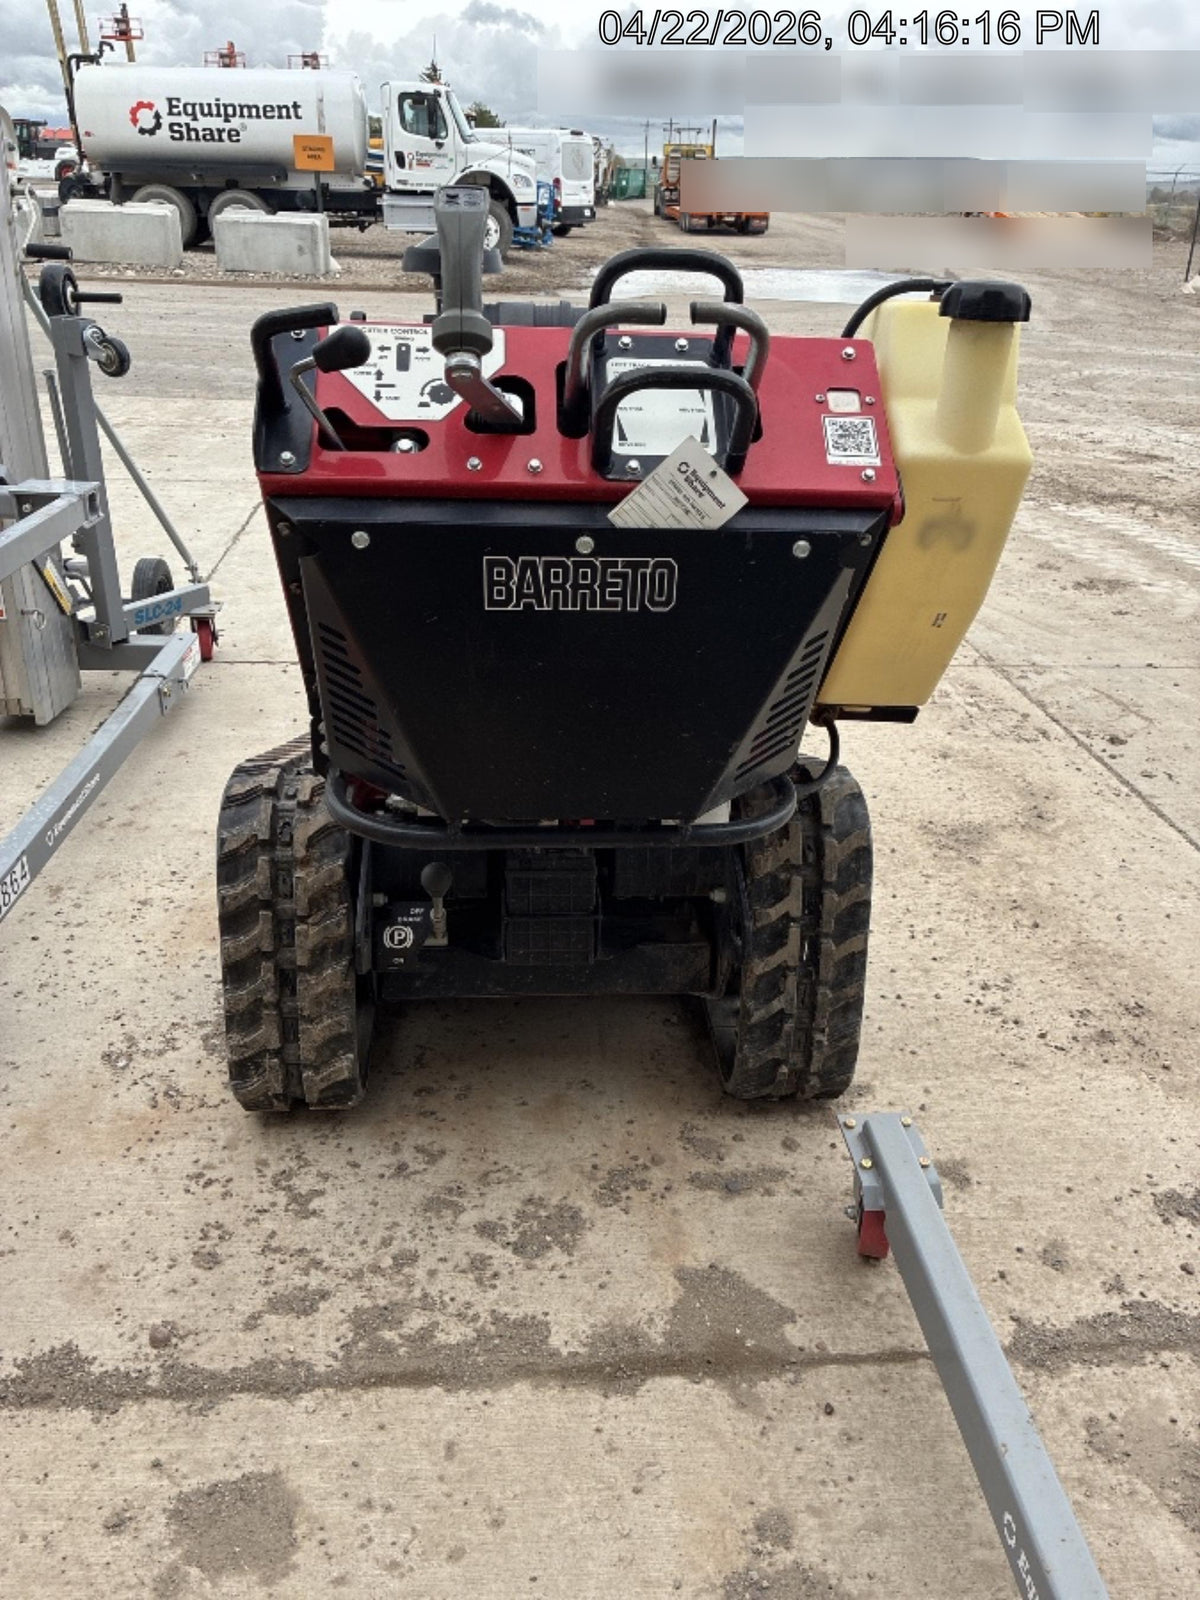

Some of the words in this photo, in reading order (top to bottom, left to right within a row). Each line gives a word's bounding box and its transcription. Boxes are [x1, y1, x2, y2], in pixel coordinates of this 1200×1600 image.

[165, 97, 303, 123] Equipment
[483, 556, 678, 612] BARRETO
[133, 597, 183, 625] SLC-24
[0, 857, 29, 916] 864
